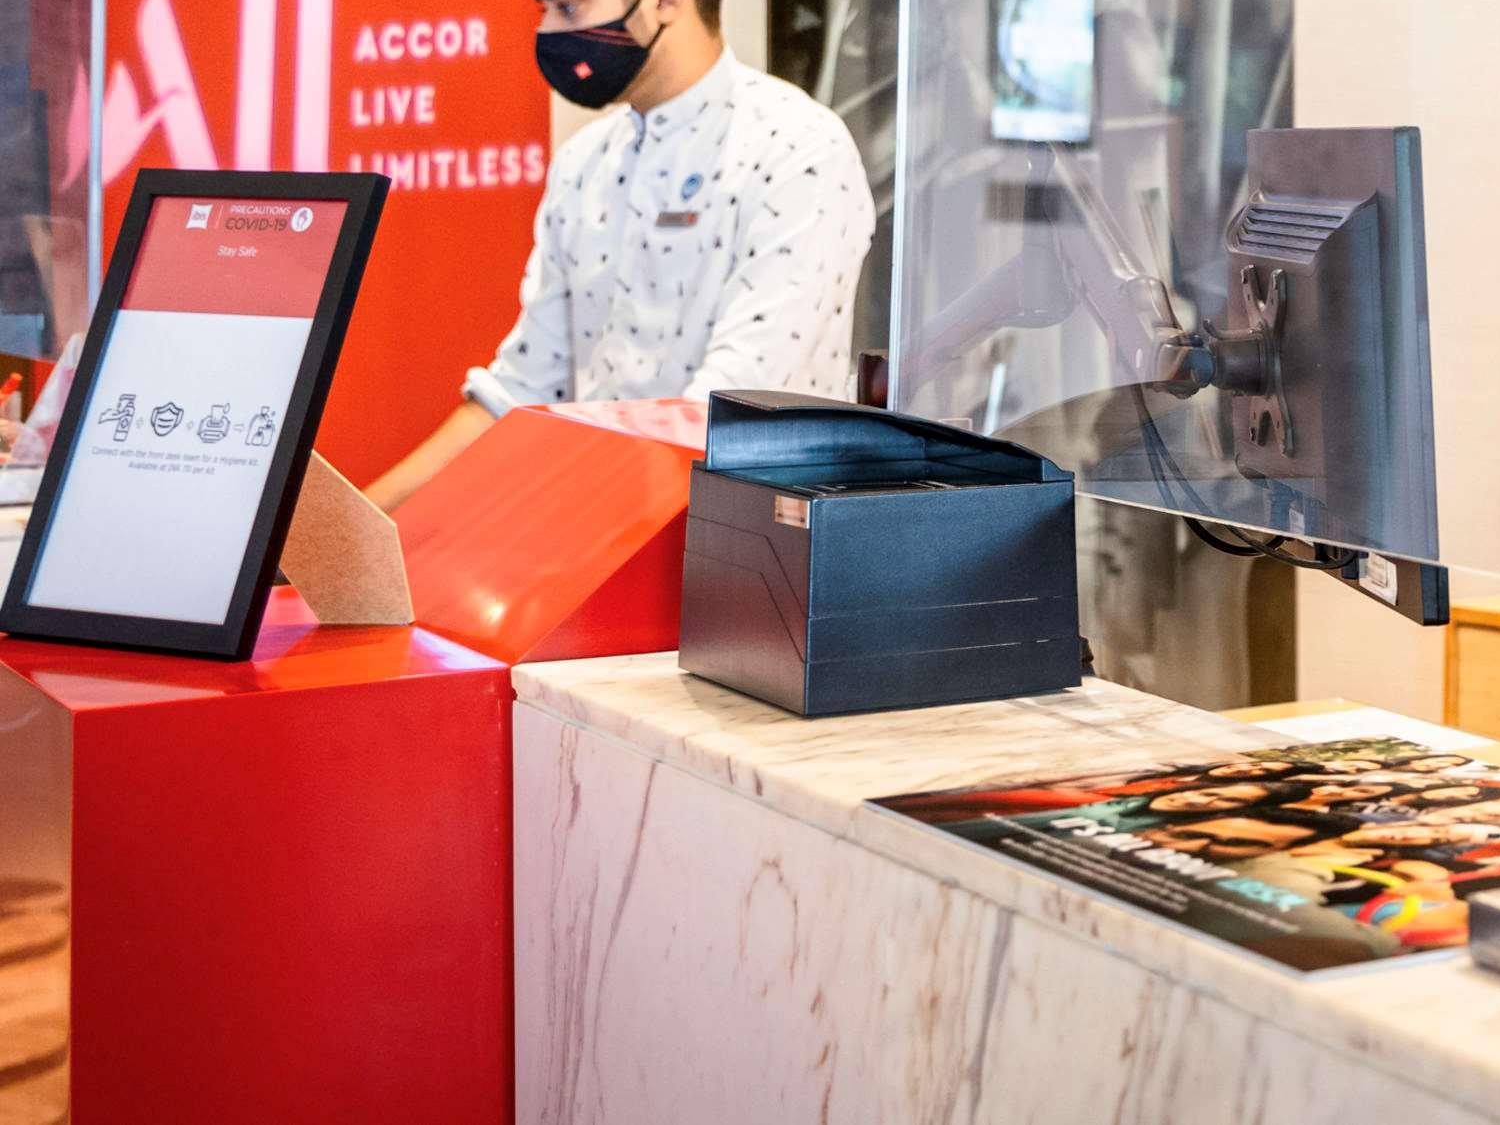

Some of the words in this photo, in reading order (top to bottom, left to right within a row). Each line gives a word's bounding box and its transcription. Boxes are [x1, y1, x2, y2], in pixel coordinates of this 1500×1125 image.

[354, 19, 489, 61] ACCOR
[350, 85, 436, 126] LIVE
[230, 205, 292, 216] PRECAUTIONS
[224, 217, 289, 232] COVID-19
[218, 245, 237, 257] Stay
[239, 246, 257, 257] Safe
